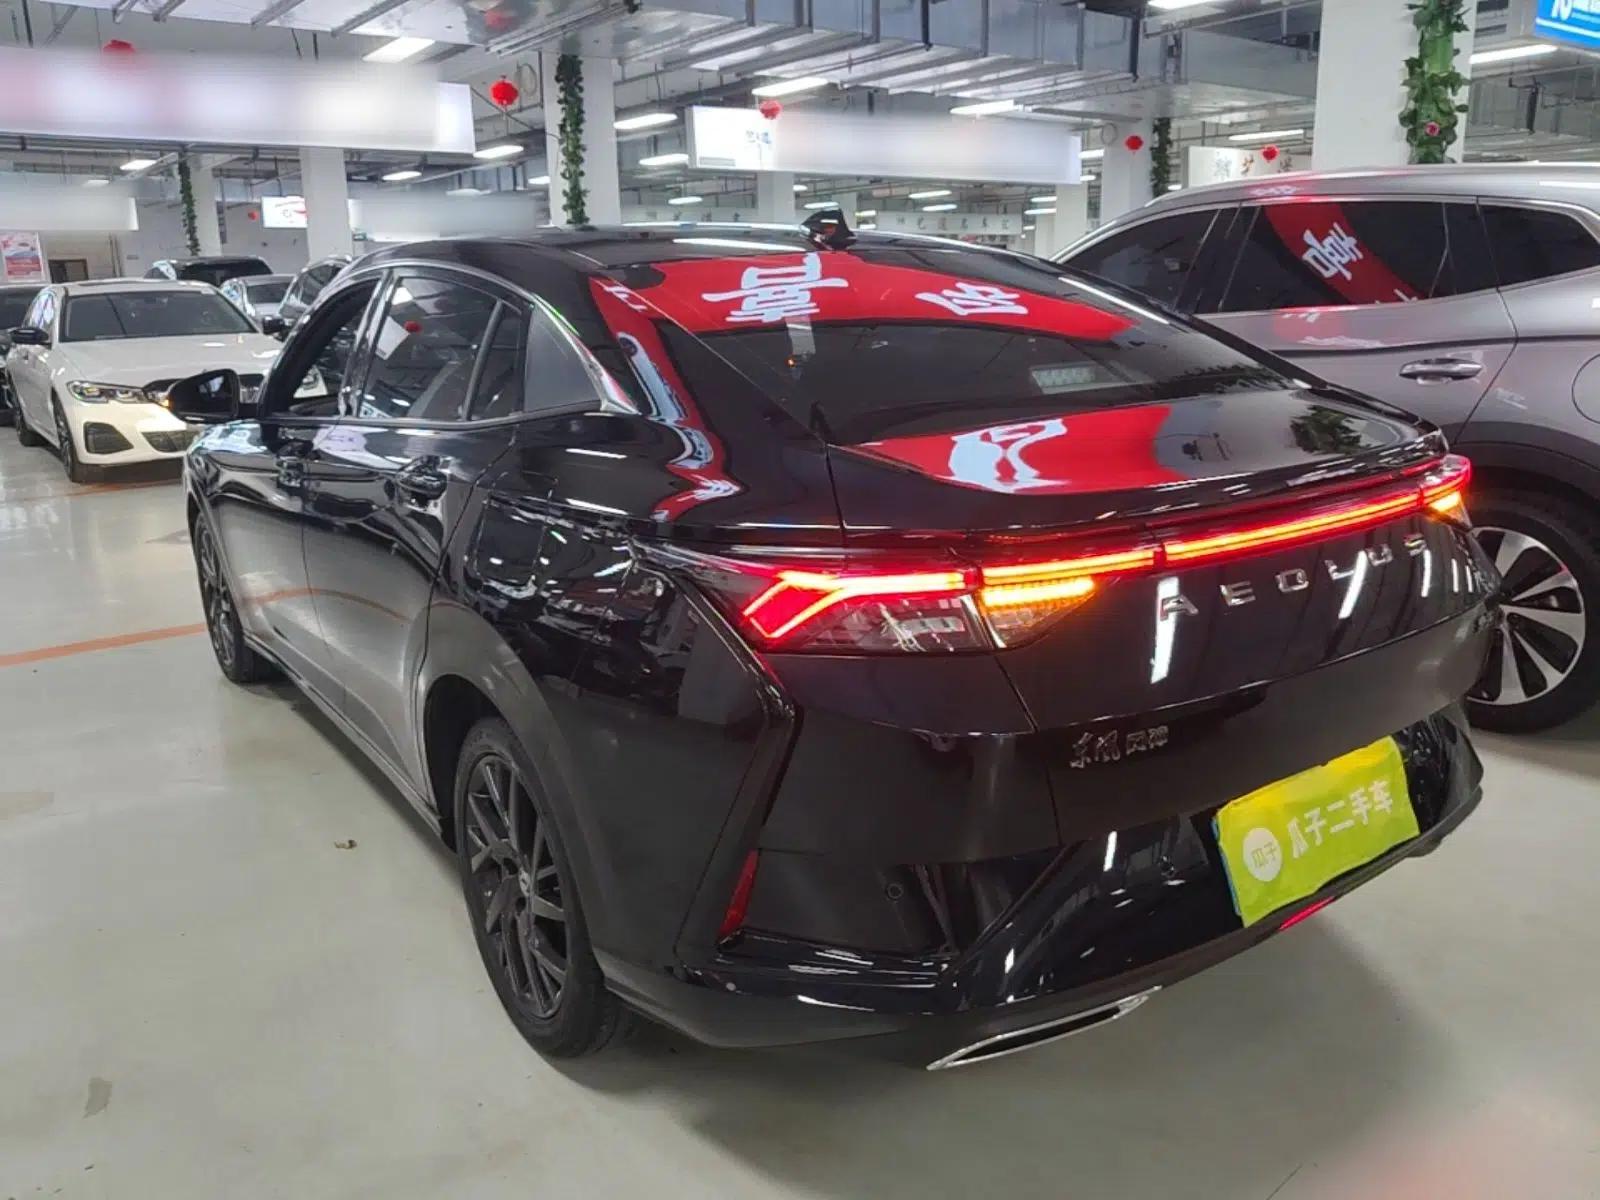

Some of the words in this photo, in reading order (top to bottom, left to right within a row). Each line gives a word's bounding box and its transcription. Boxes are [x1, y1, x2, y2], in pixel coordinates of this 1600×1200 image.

[1159, 532, 1428, 622] AEOLUS
[1287, 778, 1394, 860] 瓜子二手车
